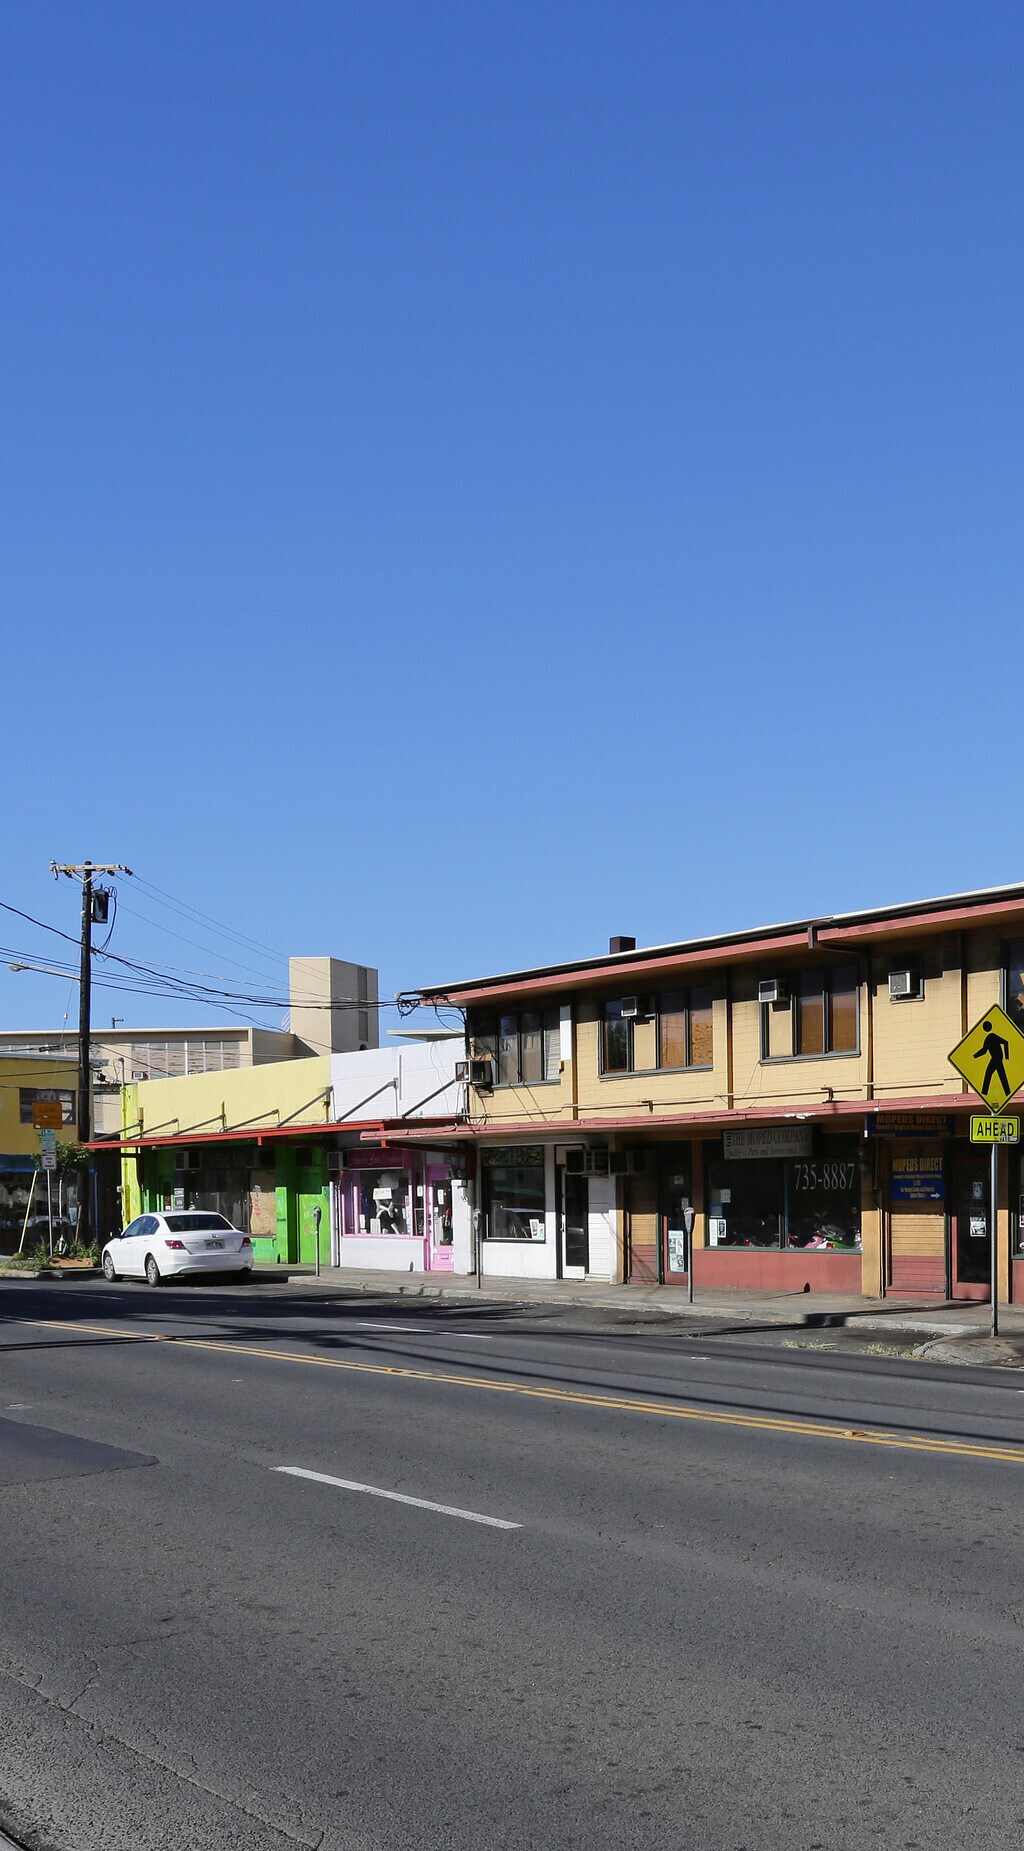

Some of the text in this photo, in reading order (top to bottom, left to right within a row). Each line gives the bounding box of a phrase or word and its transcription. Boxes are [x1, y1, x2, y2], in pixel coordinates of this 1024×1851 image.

[876, 1114, 947, 1124] MOPEDS DIRECT
[731, 1128, 809, 1146] THE MOPED COMPANY
[976, 1121, 1015, 1137] AHEAD
[892, 1157, 943, 1172] MOPEDS DIRECT
[794, 1163, 855, 1190] 735-8887
